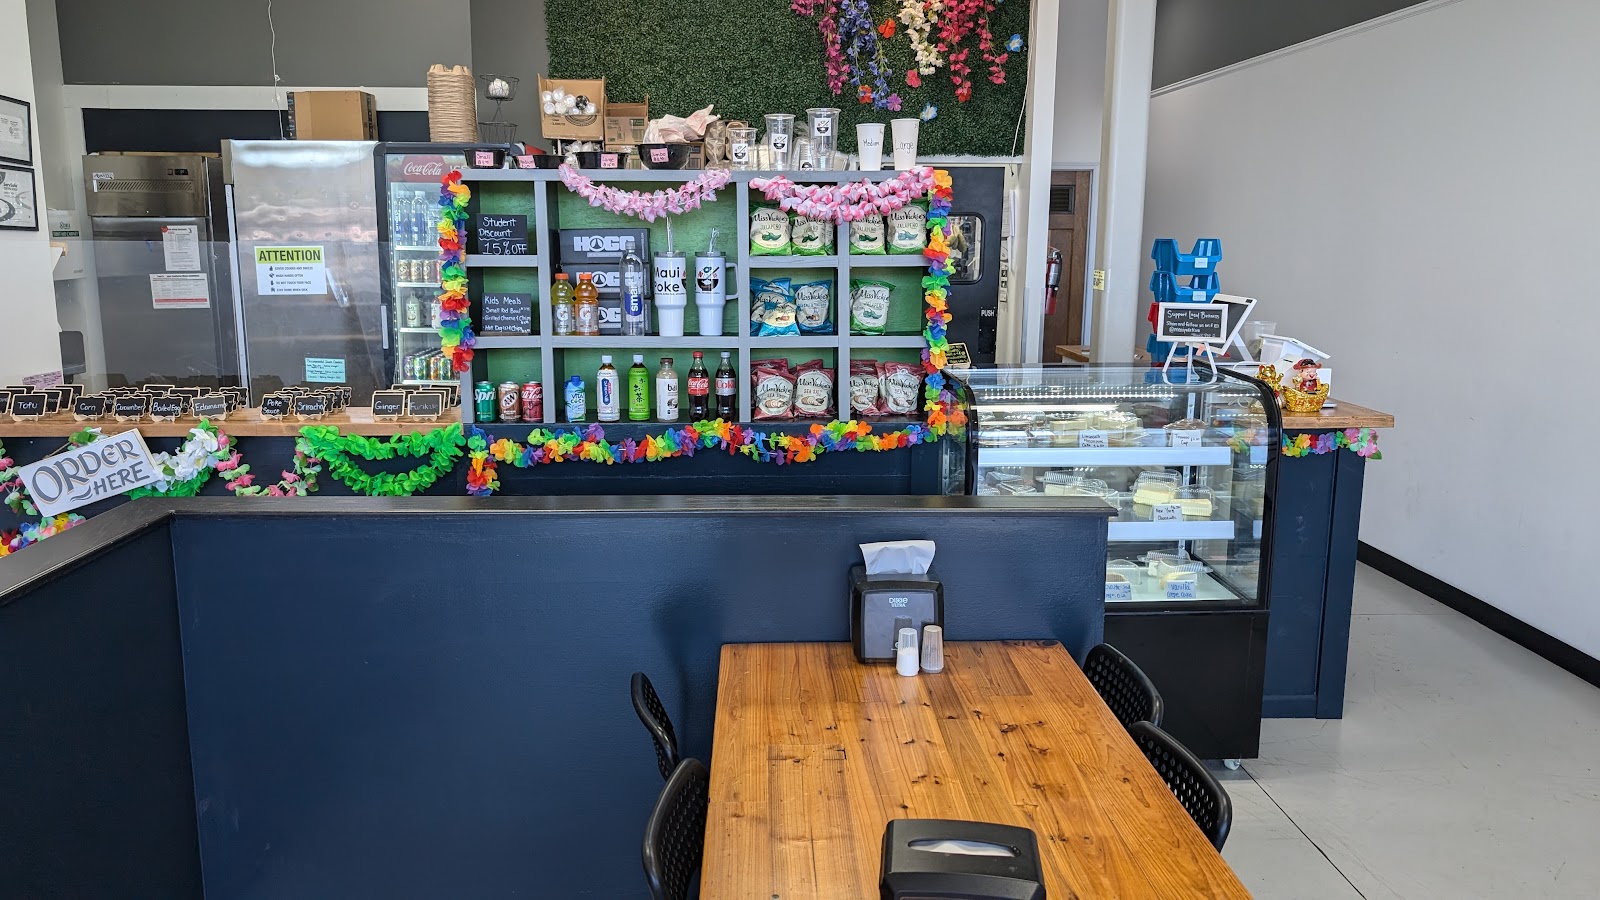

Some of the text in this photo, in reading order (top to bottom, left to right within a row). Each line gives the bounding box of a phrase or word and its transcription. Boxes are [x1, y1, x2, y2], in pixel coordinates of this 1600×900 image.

[403, 161, 444, 176] Coca-Cola
[483, 217, 517, 227] Student
[478, 228, 513, 237] Discount
[511, 243, 527, 254] OFF
[259, 249, 321, 262] ATTENTION
[484, 295, 522, 305] Kids Meals
[981, 309, 995, 317] PUSH
[1167, 310, 1187, 319] Support
[18, 401, 38, 410] Tofu
[80, 403, 96, 411] Corn
[116, 403, 144, 411] Cucumber
[375, 401, 401, 413] Ginger
[32, 439, 140, 504] ORDER
[94, 461, 150, 496] HERE
[1171, 583, 1191, 591] Vanilla
